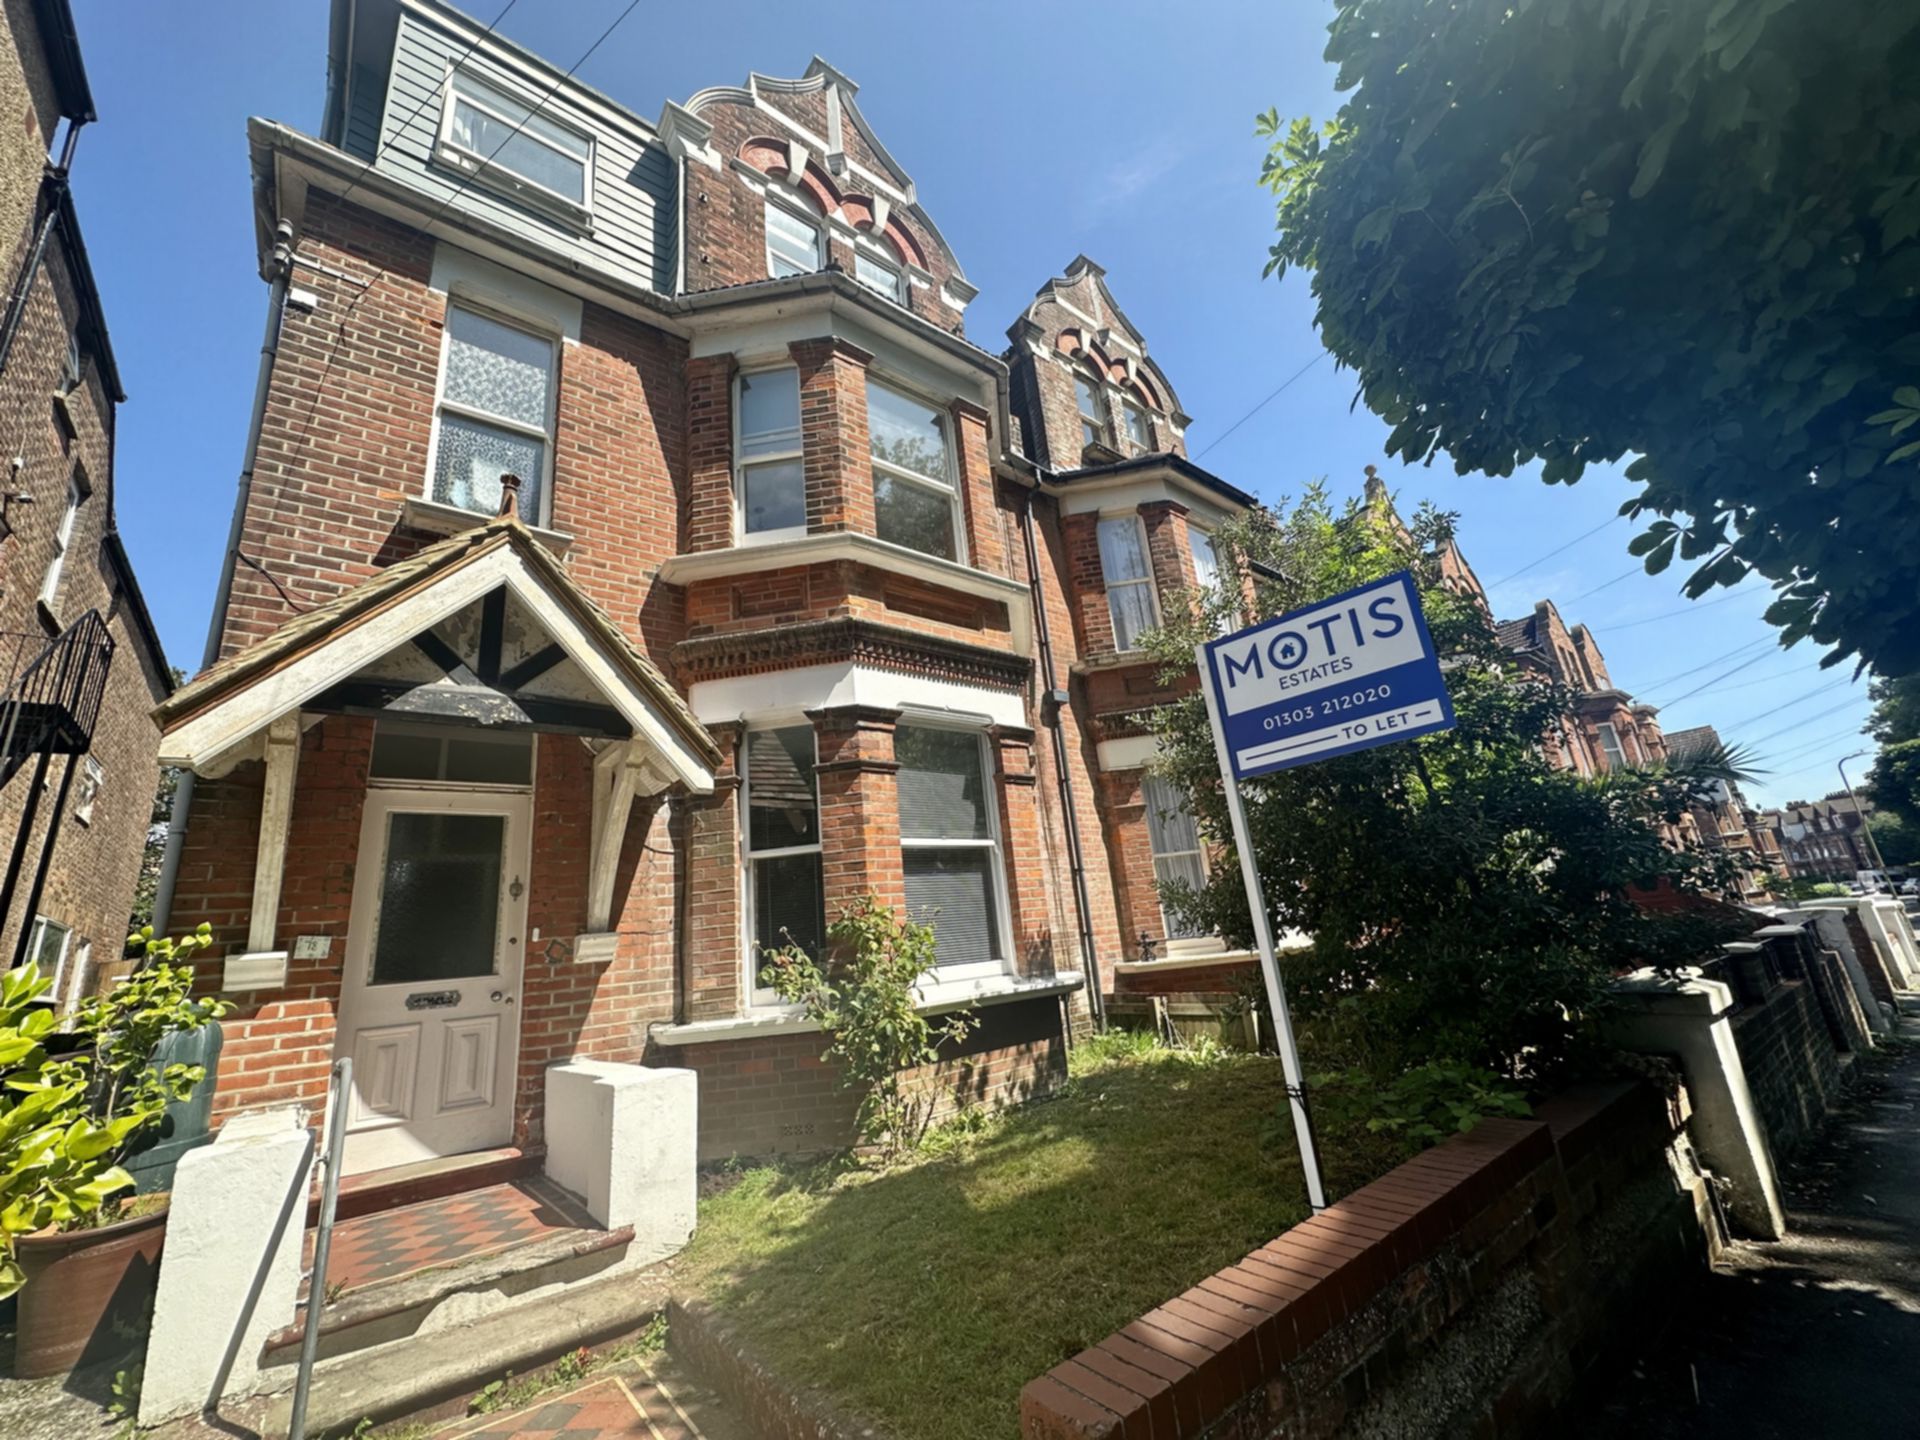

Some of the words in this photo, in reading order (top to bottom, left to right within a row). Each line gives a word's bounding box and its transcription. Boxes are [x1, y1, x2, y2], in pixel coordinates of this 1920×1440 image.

[1223, 597, 1403, 688] MOTIS
[1278, 656, 1353, 690] ESTATES
[1263, 706, 1314, 730] 01303
[1321, 684, 1391, 714] 212020
[1342, 724, 1367, 739] TO
[1376, 712, 1408, 731] LET
